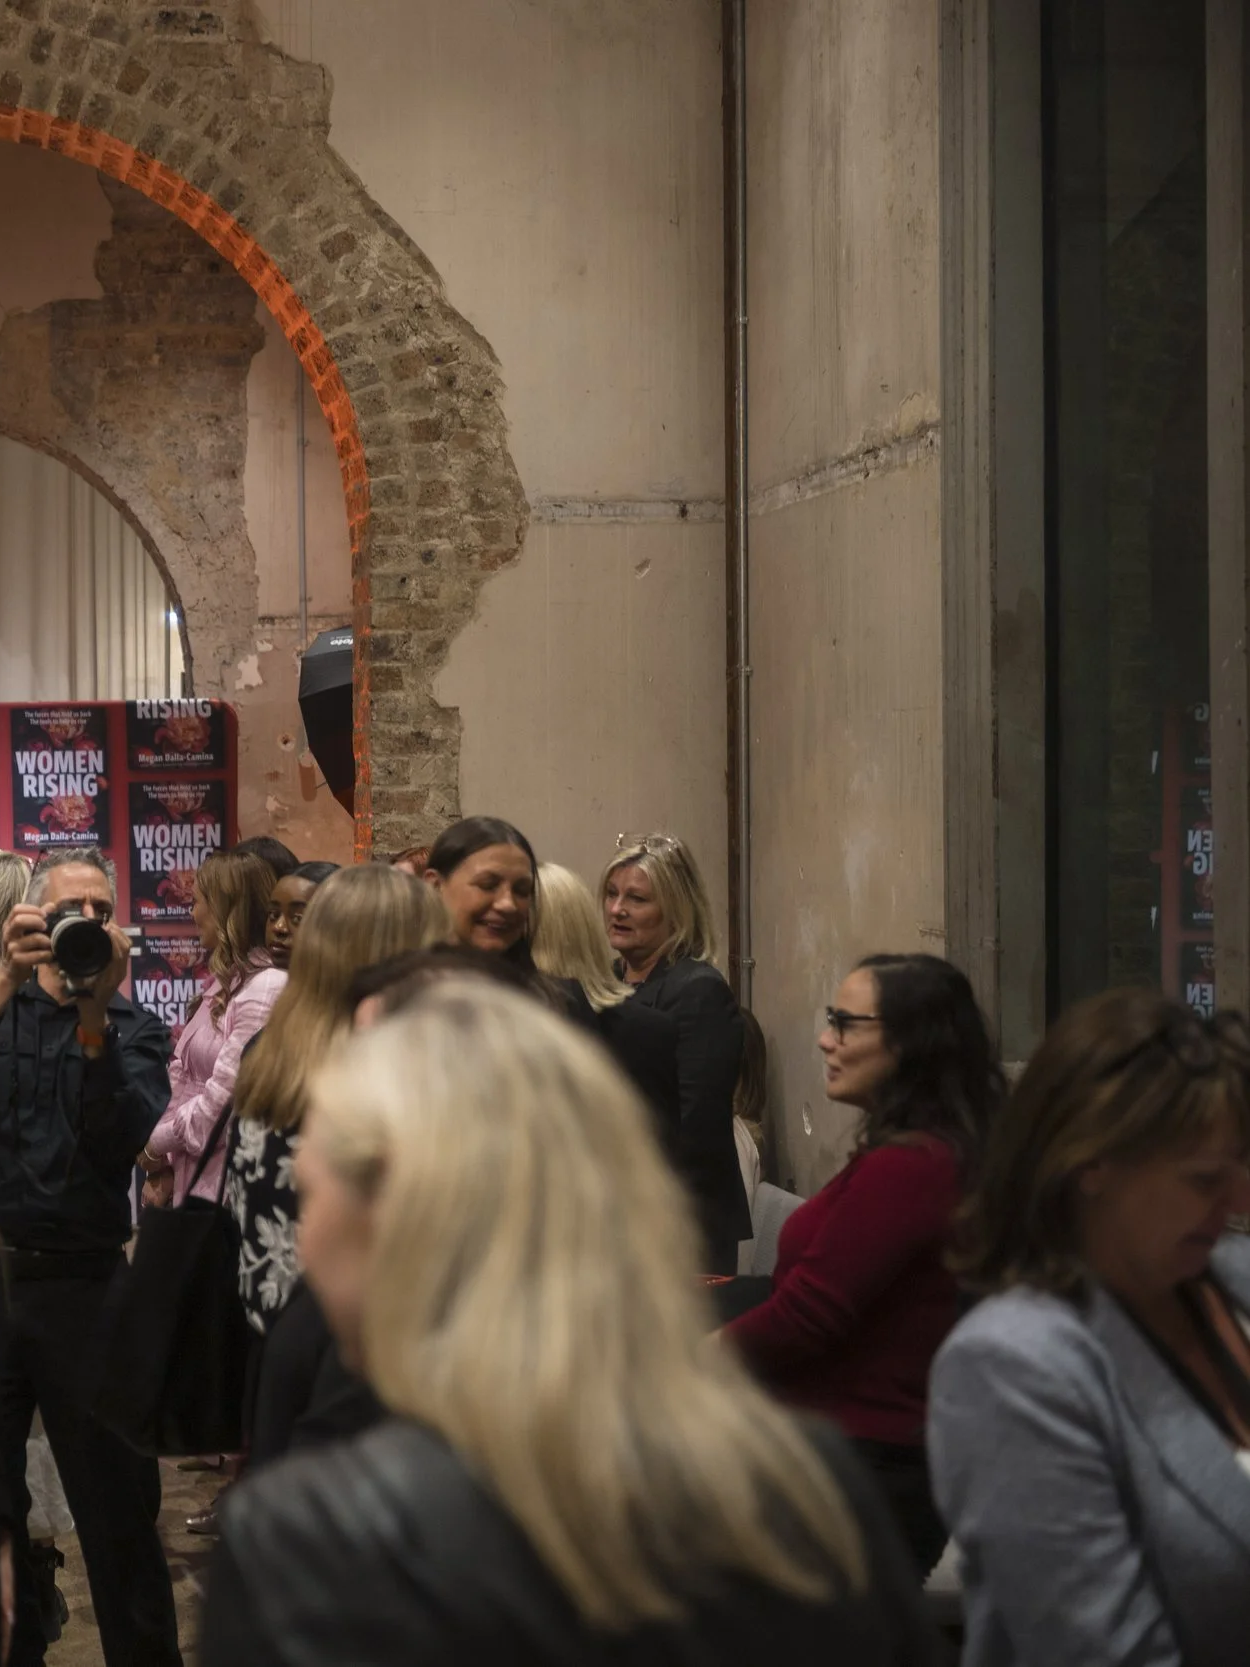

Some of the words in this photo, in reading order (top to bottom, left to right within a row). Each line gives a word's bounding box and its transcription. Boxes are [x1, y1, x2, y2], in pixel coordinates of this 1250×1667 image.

[136, 698, 212, 719] RISING
[15, 750, 104, 774] WOMEN
[138, 754, 163, 765] Megan
[165, 751, 214, 762] Dalla-Camina
[23, 773, 98, 797] RISING
[143, 784, 152, 792] The
[152, 784, 168, 792] forces
[148, 791, 158, 799] The
[24, 832, 49, 843] Megan
[50, 830, 99, 841] Dalla-Camina
[133, 824, 221, 848] WOMEN
[141, 906, 166, 917] Megan
[167, 905, 193, 915] Dalla-C
[145, 939, 154, 947] The
[170, 938, 181, 946] that
[150, 946, 160, 954] The
[135, 979, 206, 1003] WOME
